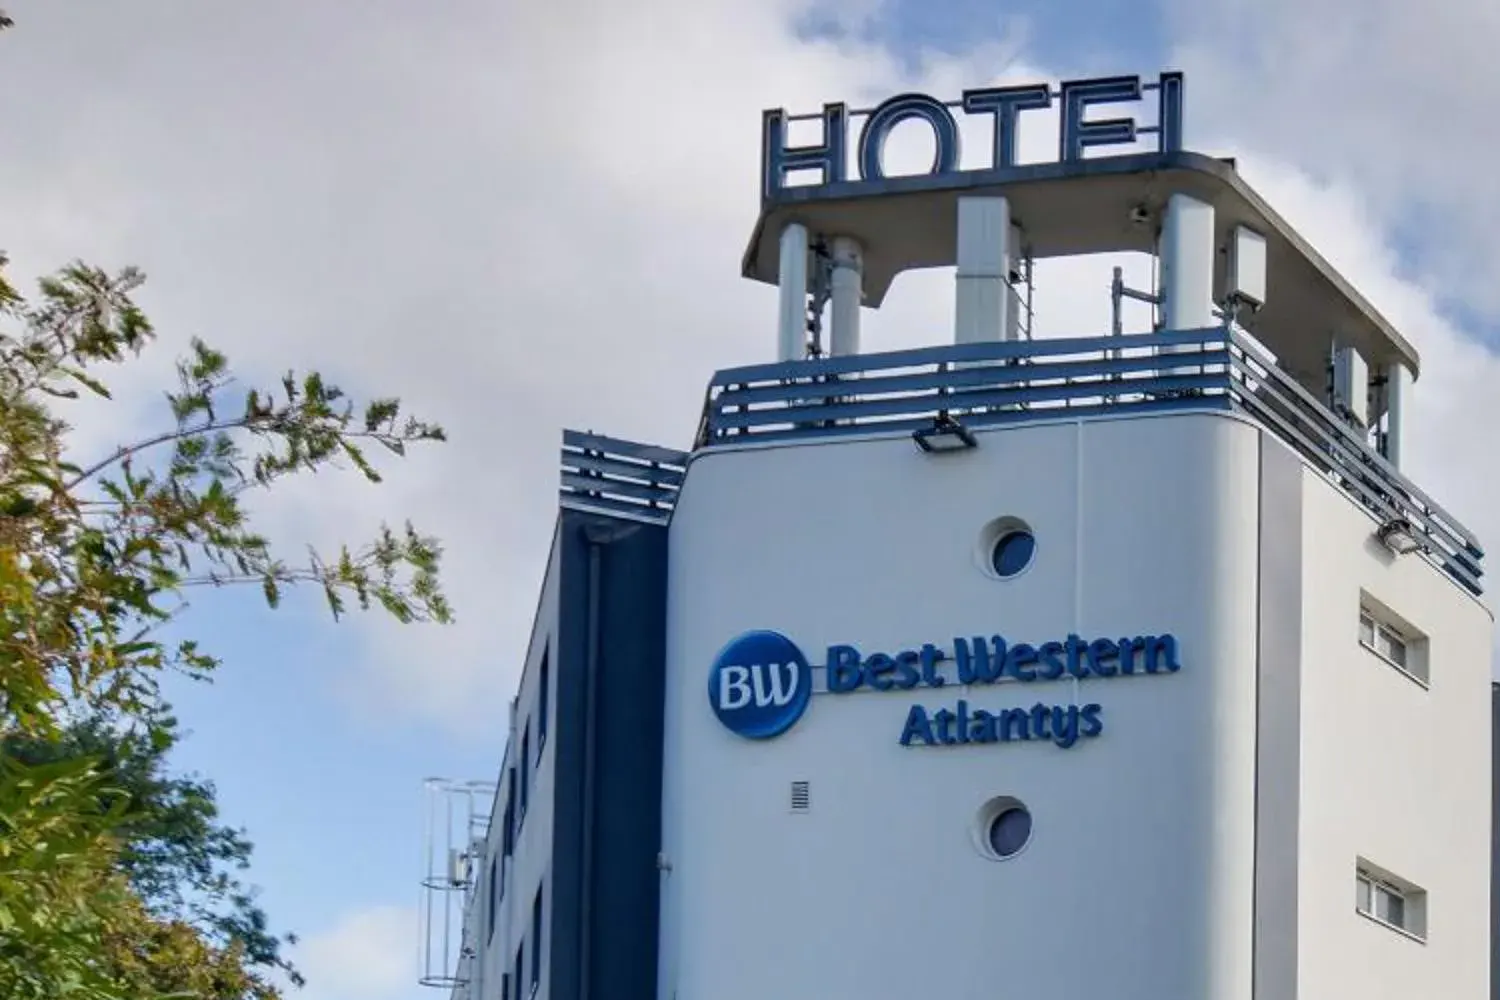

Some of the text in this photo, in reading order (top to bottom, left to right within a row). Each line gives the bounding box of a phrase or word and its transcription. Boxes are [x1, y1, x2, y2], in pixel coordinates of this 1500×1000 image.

[718, 661, 798, 710] BW
[826, 633, 1181, 692] Best Western
[900, 700, 1103, 749] Atlantys
